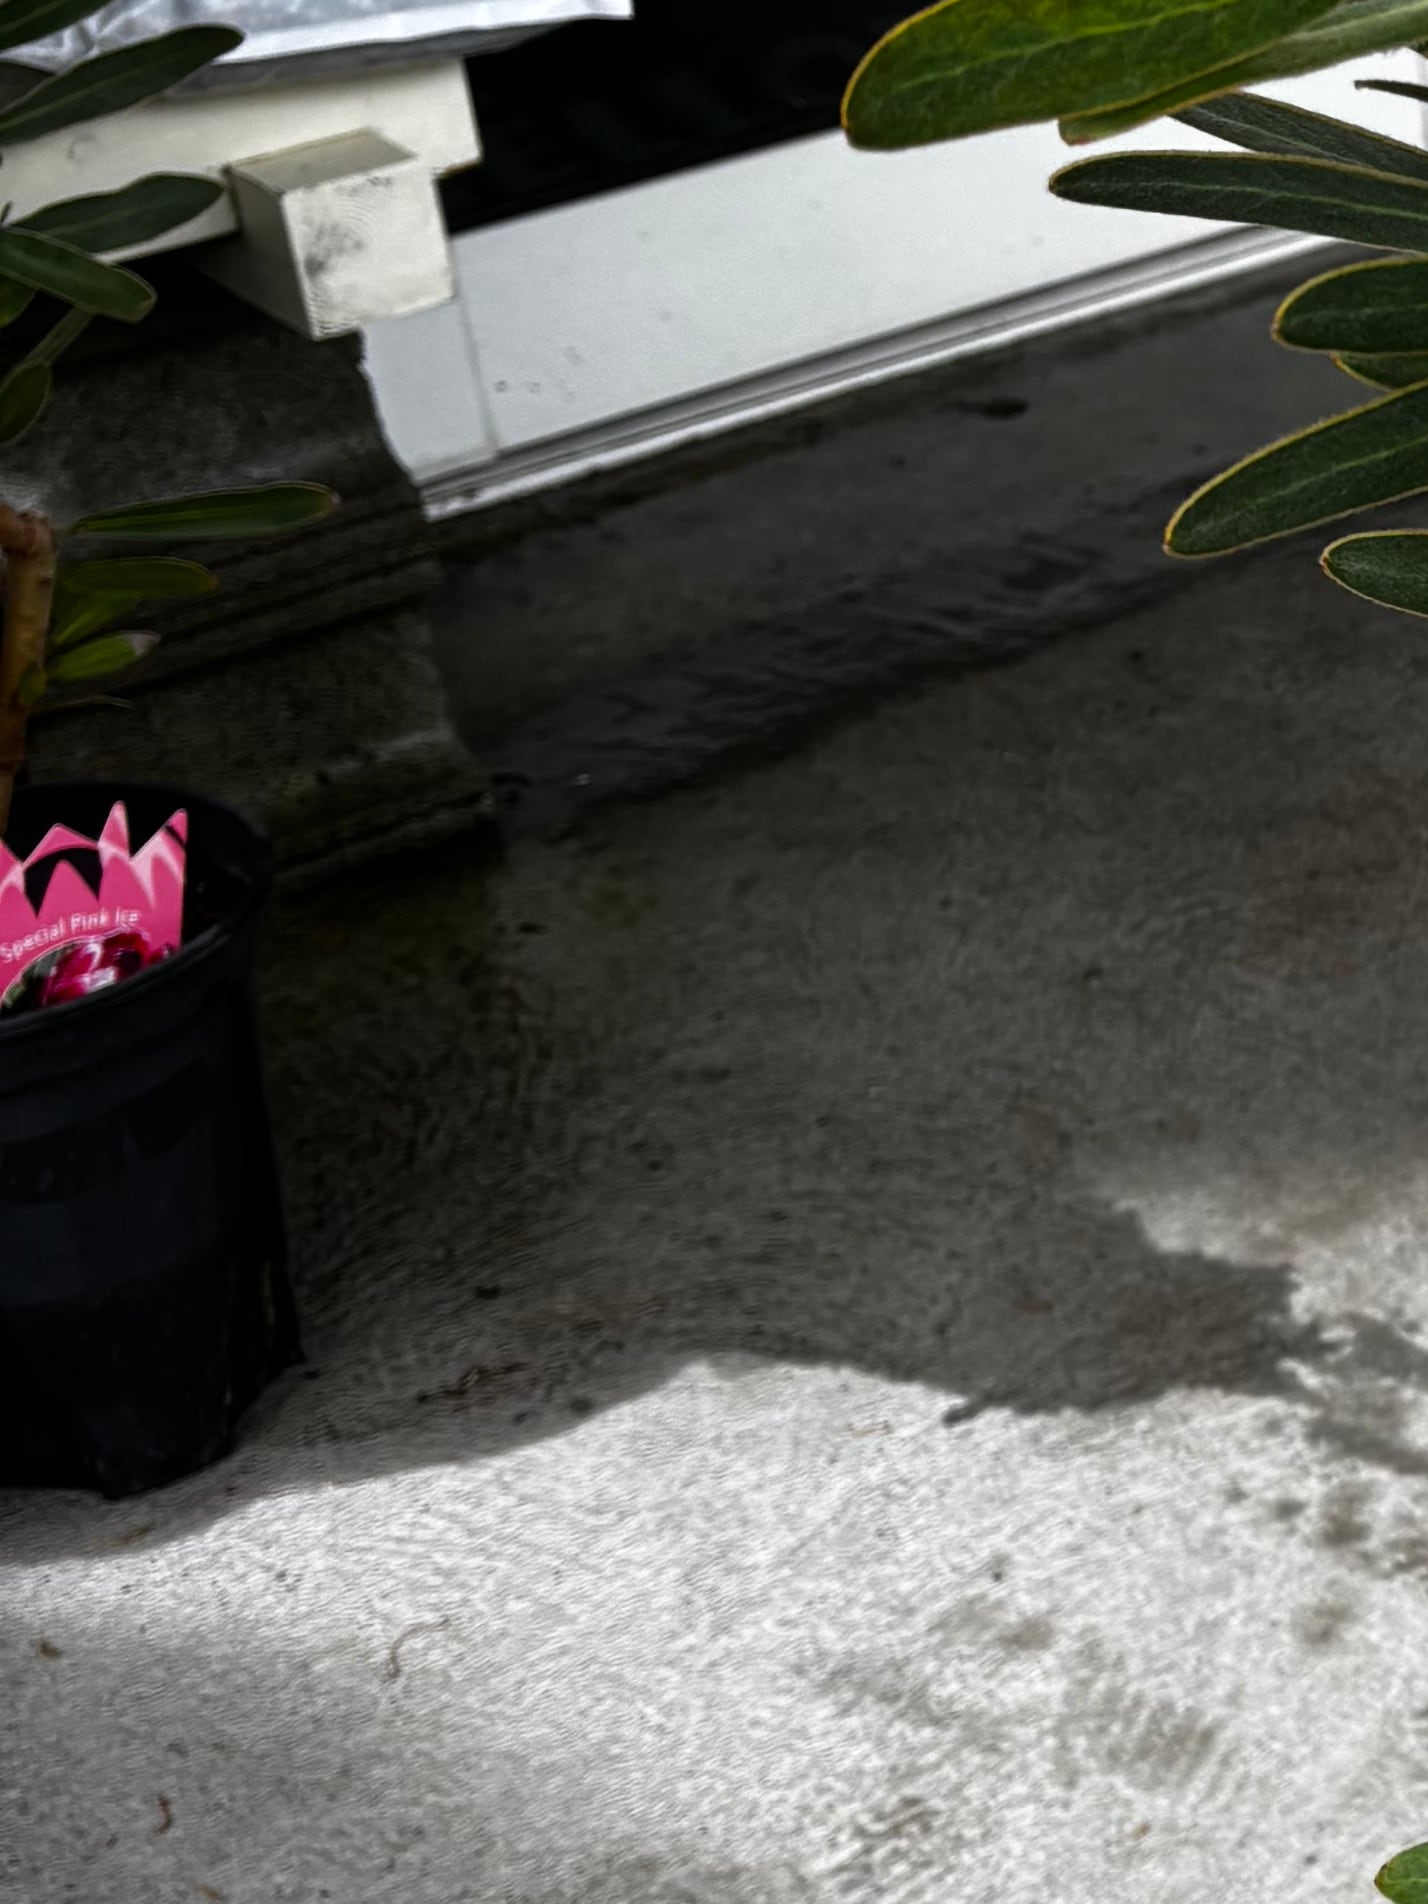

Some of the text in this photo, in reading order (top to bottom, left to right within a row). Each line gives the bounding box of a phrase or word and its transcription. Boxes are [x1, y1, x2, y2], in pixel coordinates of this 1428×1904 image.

[0, 906, 140, 963] Special Pink Ice
